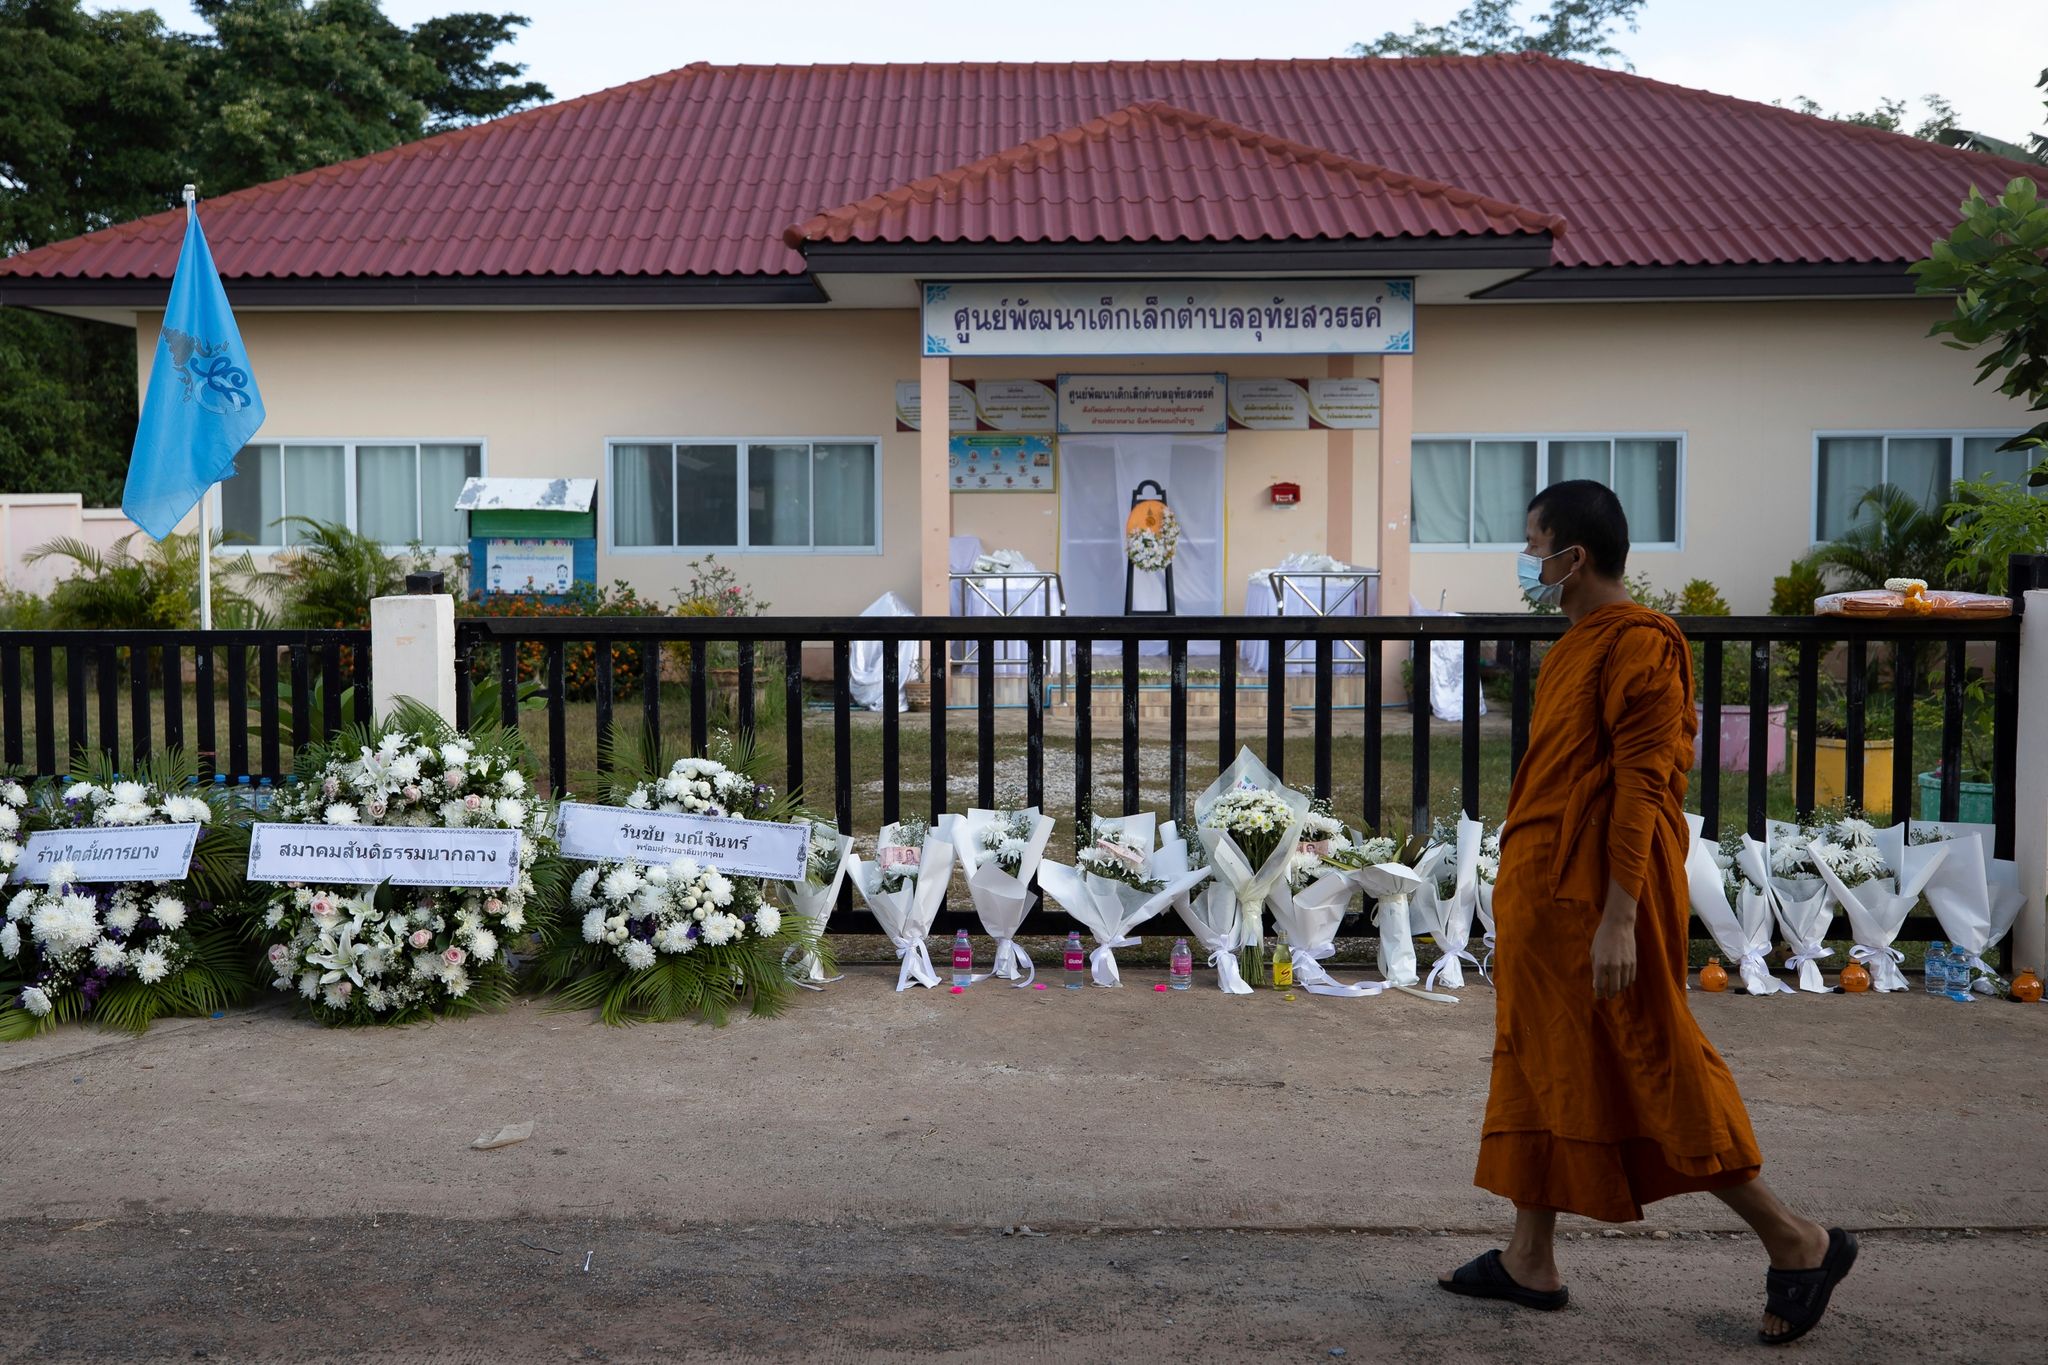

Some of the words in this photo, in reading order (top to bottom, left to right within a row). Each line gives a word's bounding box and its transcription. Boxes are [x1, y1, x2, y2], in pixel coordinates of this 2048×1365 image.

[953, 295, 1383, 344] ศูนย์พัฒนาเด็กเล็กตำบลอุทัยสวรรค์
[620, 823, 665, 843] วันชัย
[674, 830, 752, 850] มณีจันทร์
[279, 841, 497, 863] สมาคมสันติธรรมนากลาง
